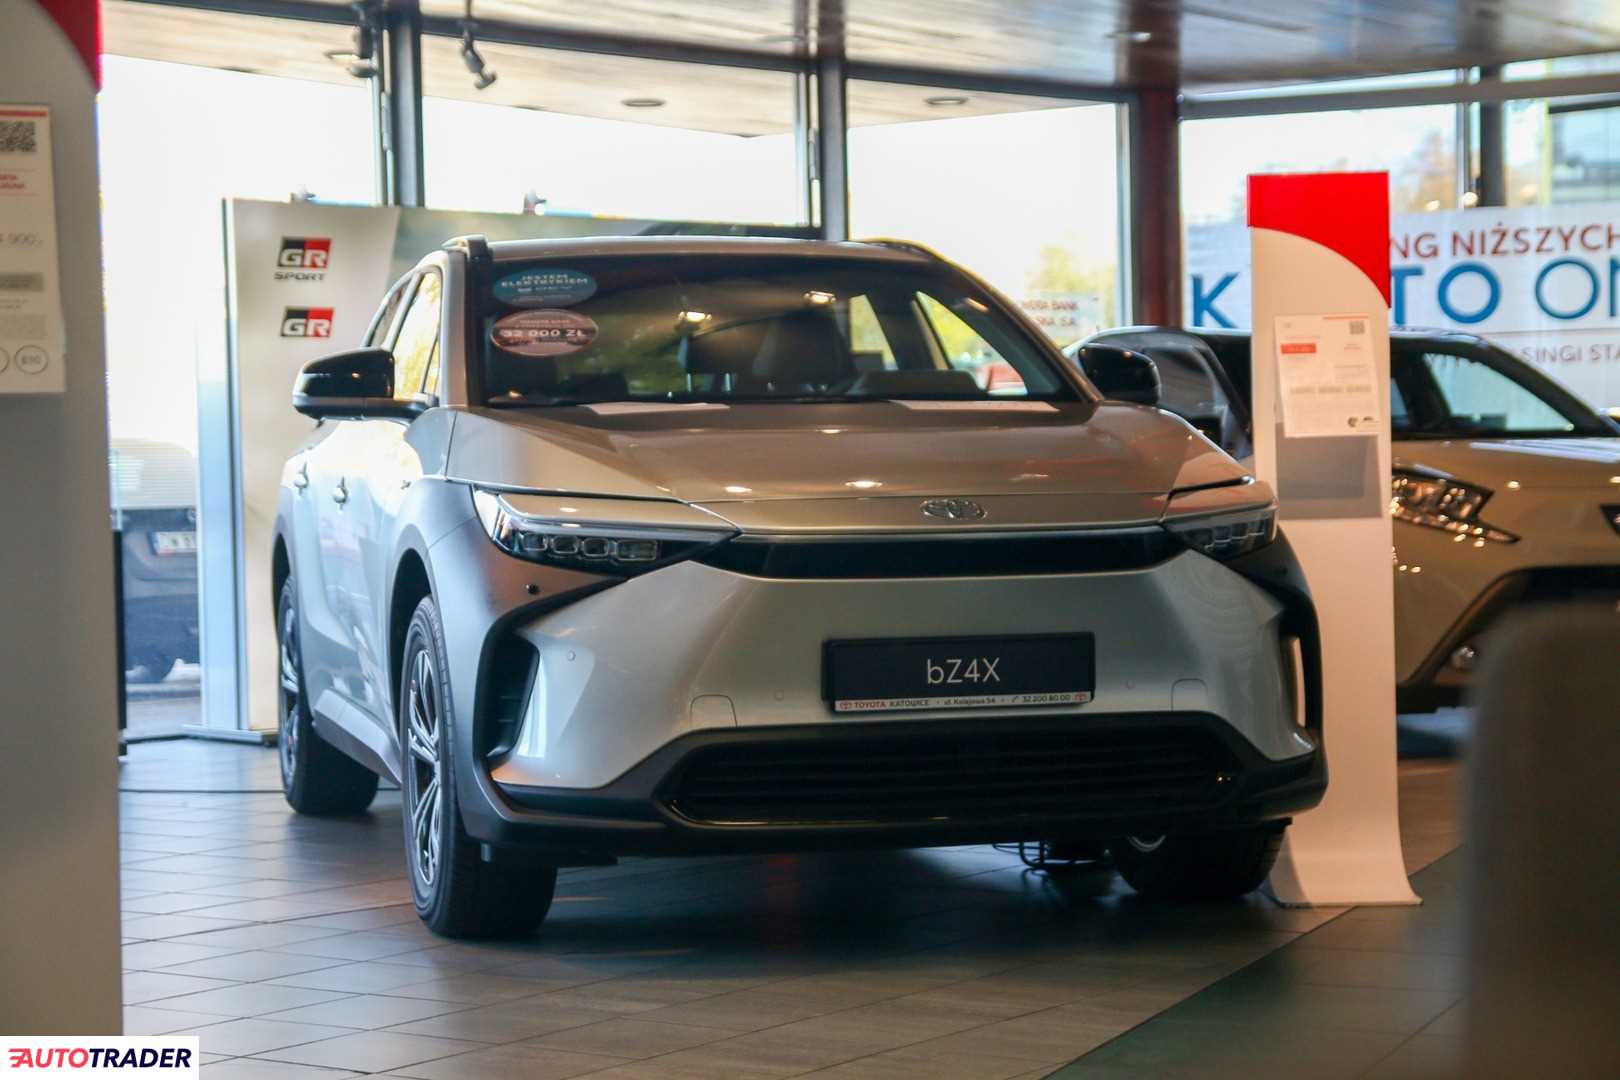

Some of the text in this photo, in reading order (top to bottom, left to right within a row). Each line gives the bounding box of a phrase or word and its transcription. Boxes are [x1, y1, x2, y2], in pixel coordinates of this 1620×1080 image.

[1390, 232, 1439, 259] NG
[279, 248, 328, 268] GR
[274, 271, 326, 281] SPORT
[282, 317, 331, 337] GR
[1520, 343, 1584, 364] SINGI
[926, 657, 1001, 685] bZ4X
[854, 700, 887, 710] TOYOTA
[889, 698, 929, 708] KATOWICE
